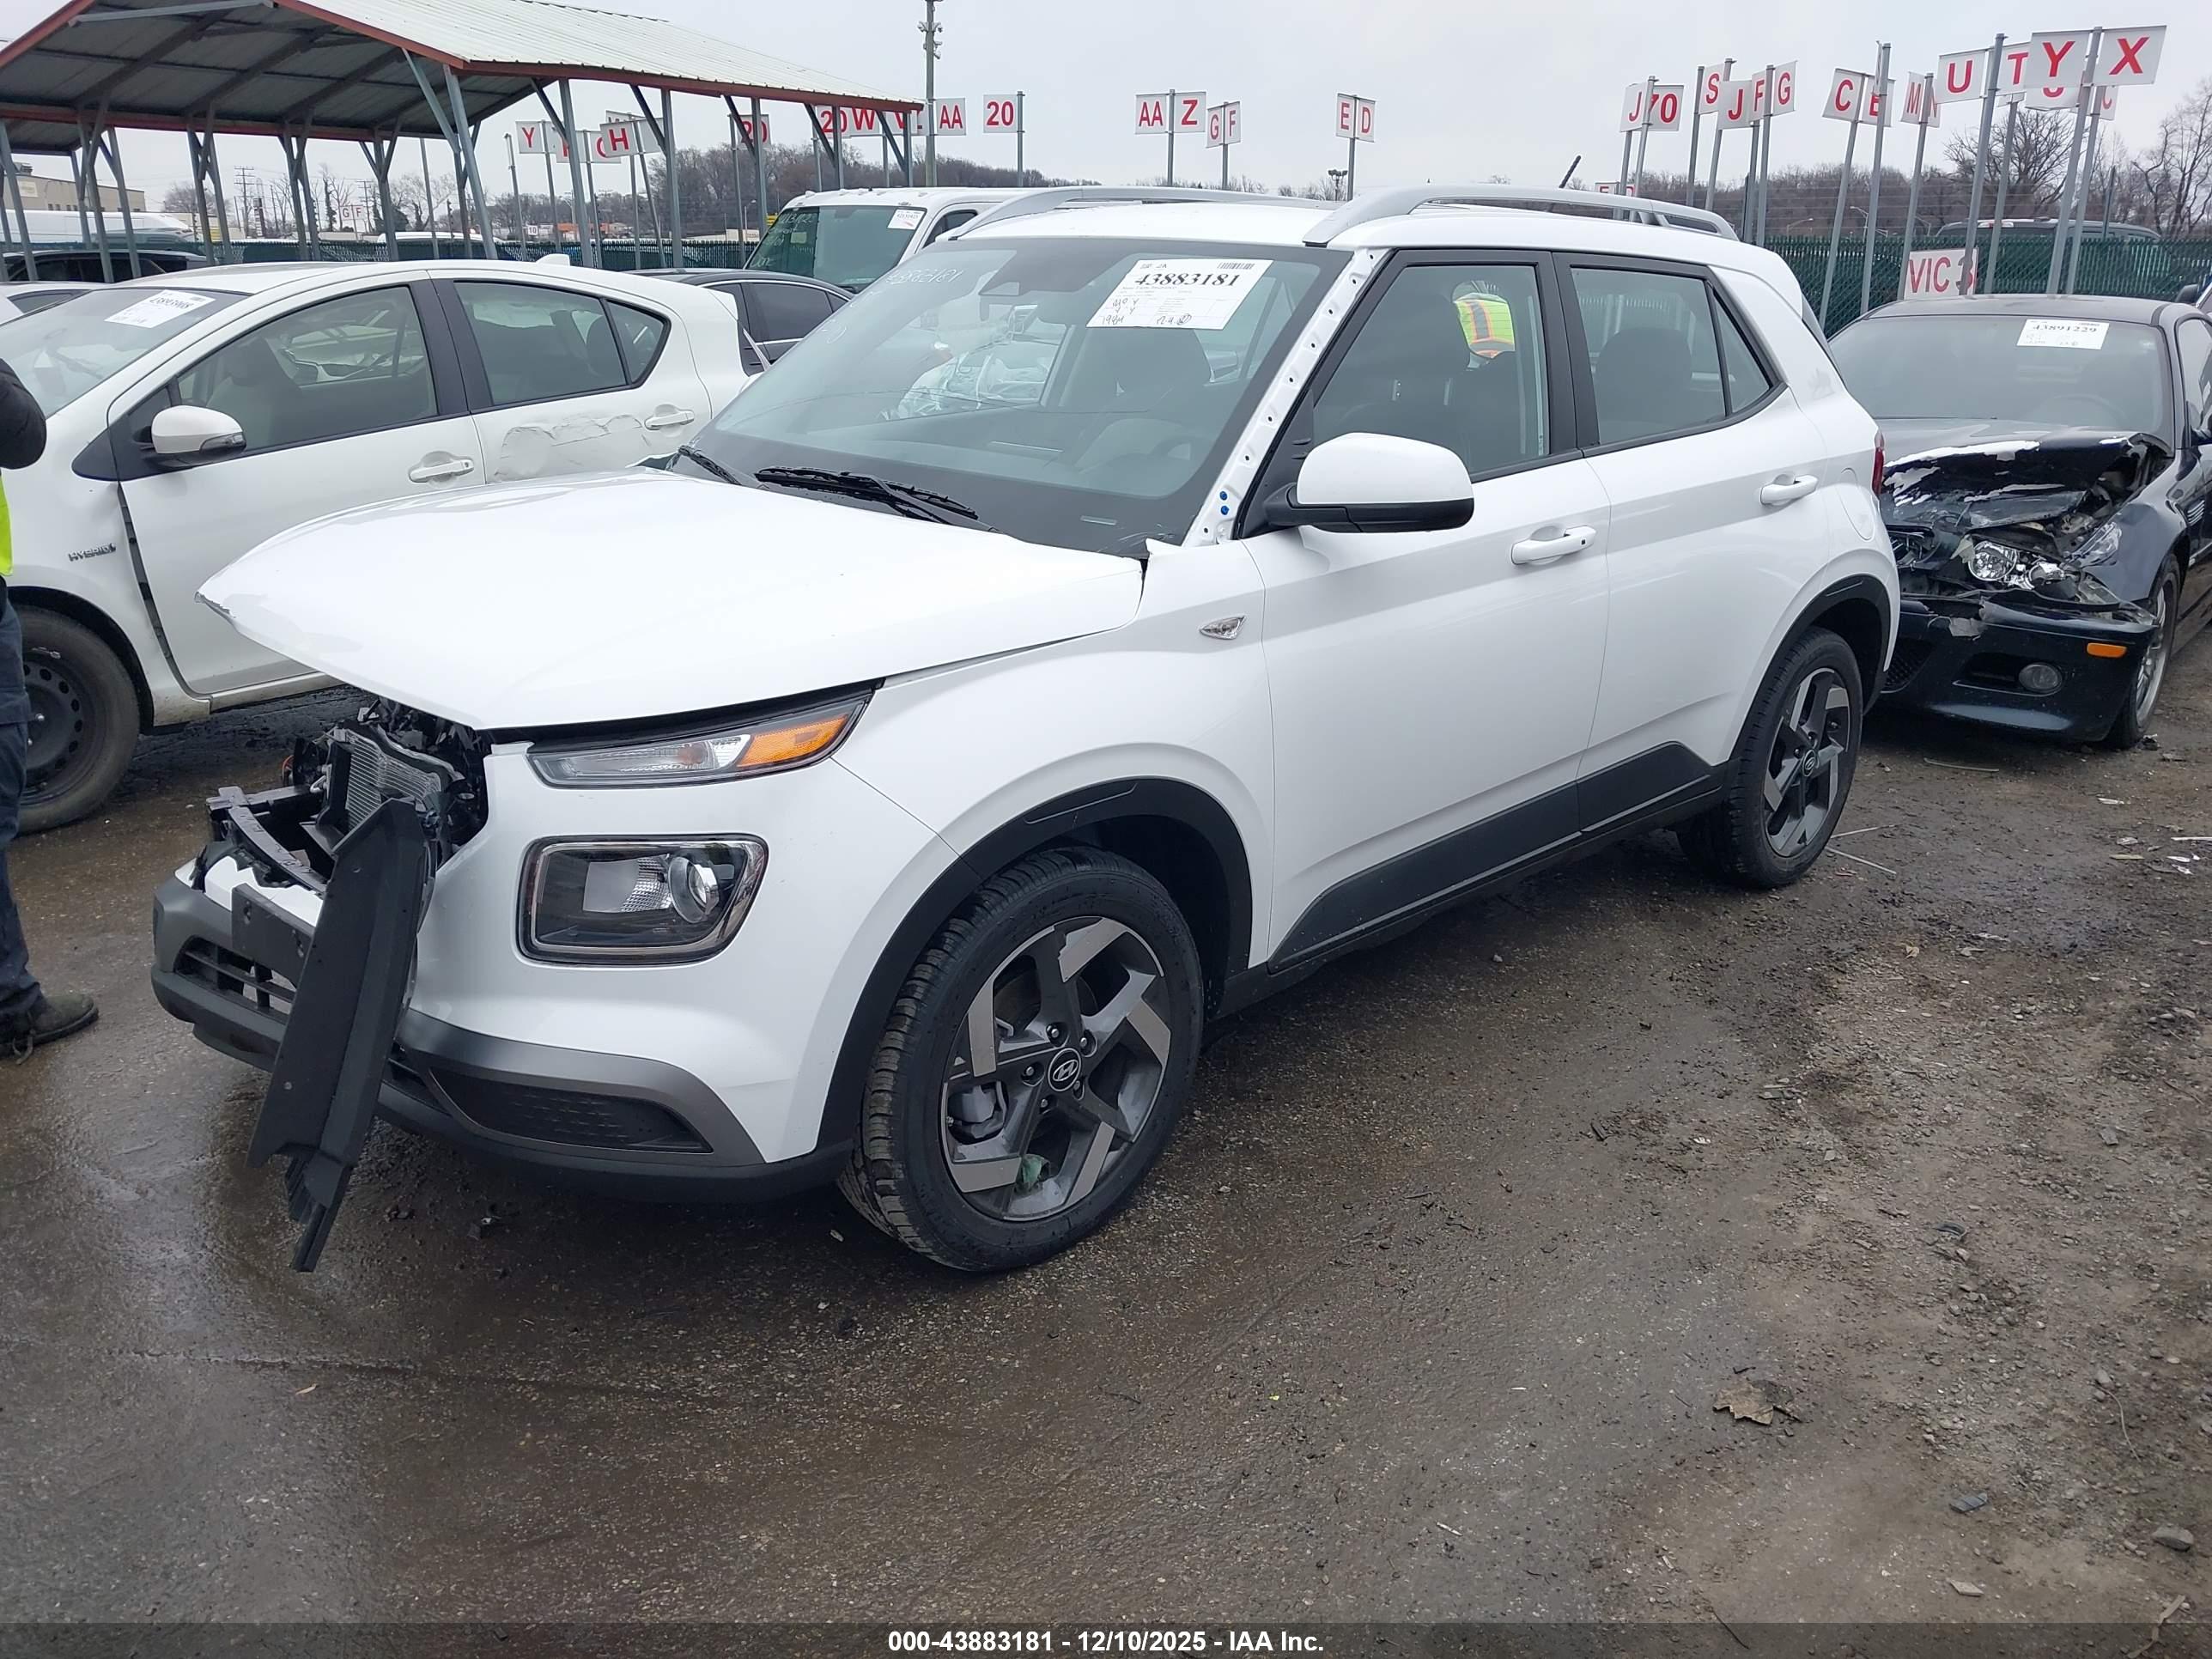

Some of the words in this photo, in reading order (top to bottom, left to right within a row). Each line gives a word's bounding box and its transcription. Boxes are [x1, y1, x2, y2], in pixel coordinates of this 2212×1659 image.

[1947, 59, 1973, 94] U
[2007, 52, 2029, 86] T
[2042, 40, 2076, 78] Y
[2108, 36, 2150, 76] X
[1705, 72, 1720, 105] S
[1728, 88, 1744, 120] J
[1753, 79, 1765, 112] F
[1778, 72, 1791, 106] G
[1835, 79, 1854, 112] C
[1906, 82, 1922, 115] M
[852, 107, 875, 131] W
[939, 105, 963, 129] AA
[986, 100, 1014, 126] 20
[1138, 100, 1164, 127] AA
[1181, 99, 1198, 125] Z
[1340, 101, 1350, 131] E
[1361, 106, 1371, 134] D
[1628, 90, 1643, 122] J
[521, 126, 535, 149] Y
[608, 127, 629, 151] H
[1210, 113, 1219, 140] G
[1229, 109, 1237, 137] F
[1134, 272, 1240, 286] 43883181
[1909, 256, 1951, 294] VIC
